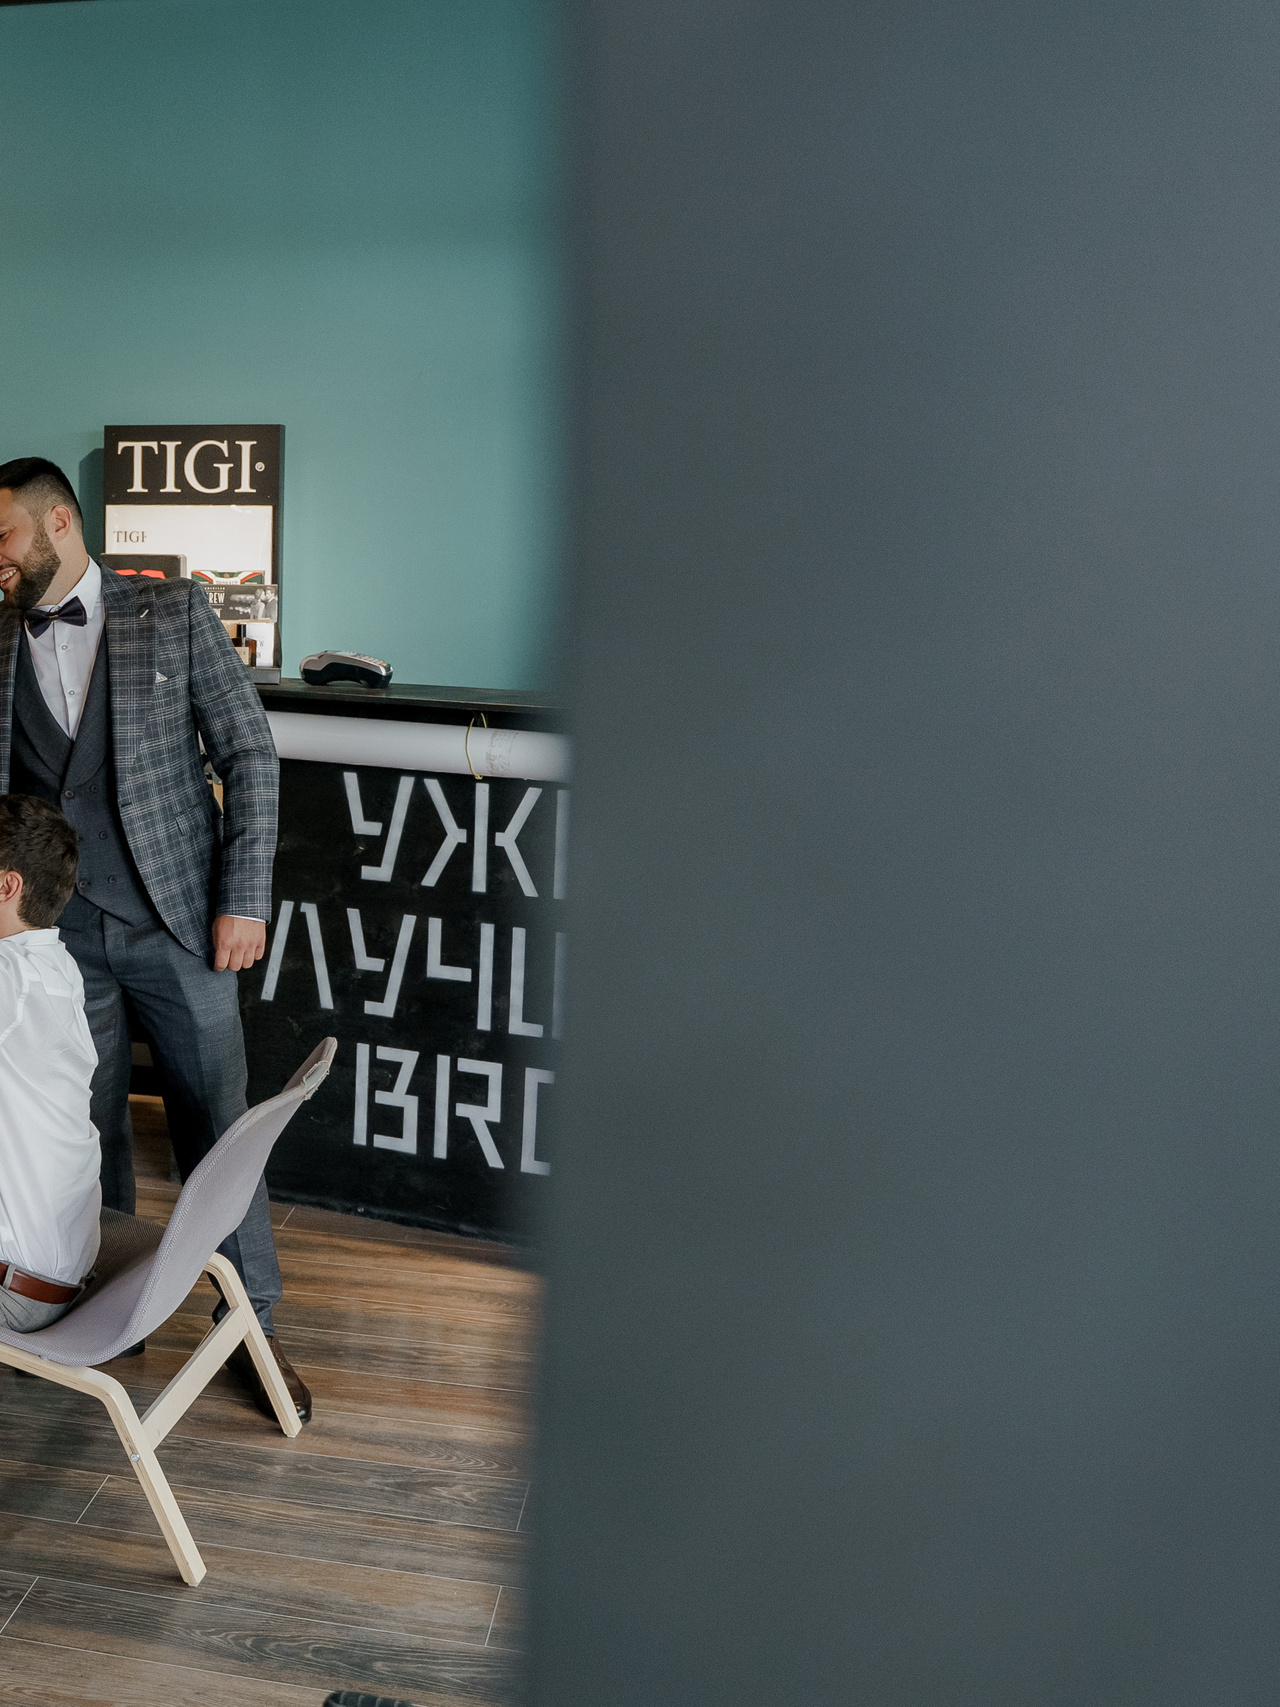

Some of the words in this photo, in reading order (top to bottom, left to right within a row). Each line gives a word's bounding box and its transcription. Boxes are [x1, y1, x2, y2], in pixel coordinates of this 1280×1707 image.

[117, 440, 258, 494] TIGI
[113, 530, 147, 544] TIGI
[206, 592, 225, 604] REW
[342, 771, 570, 899] УЖ
